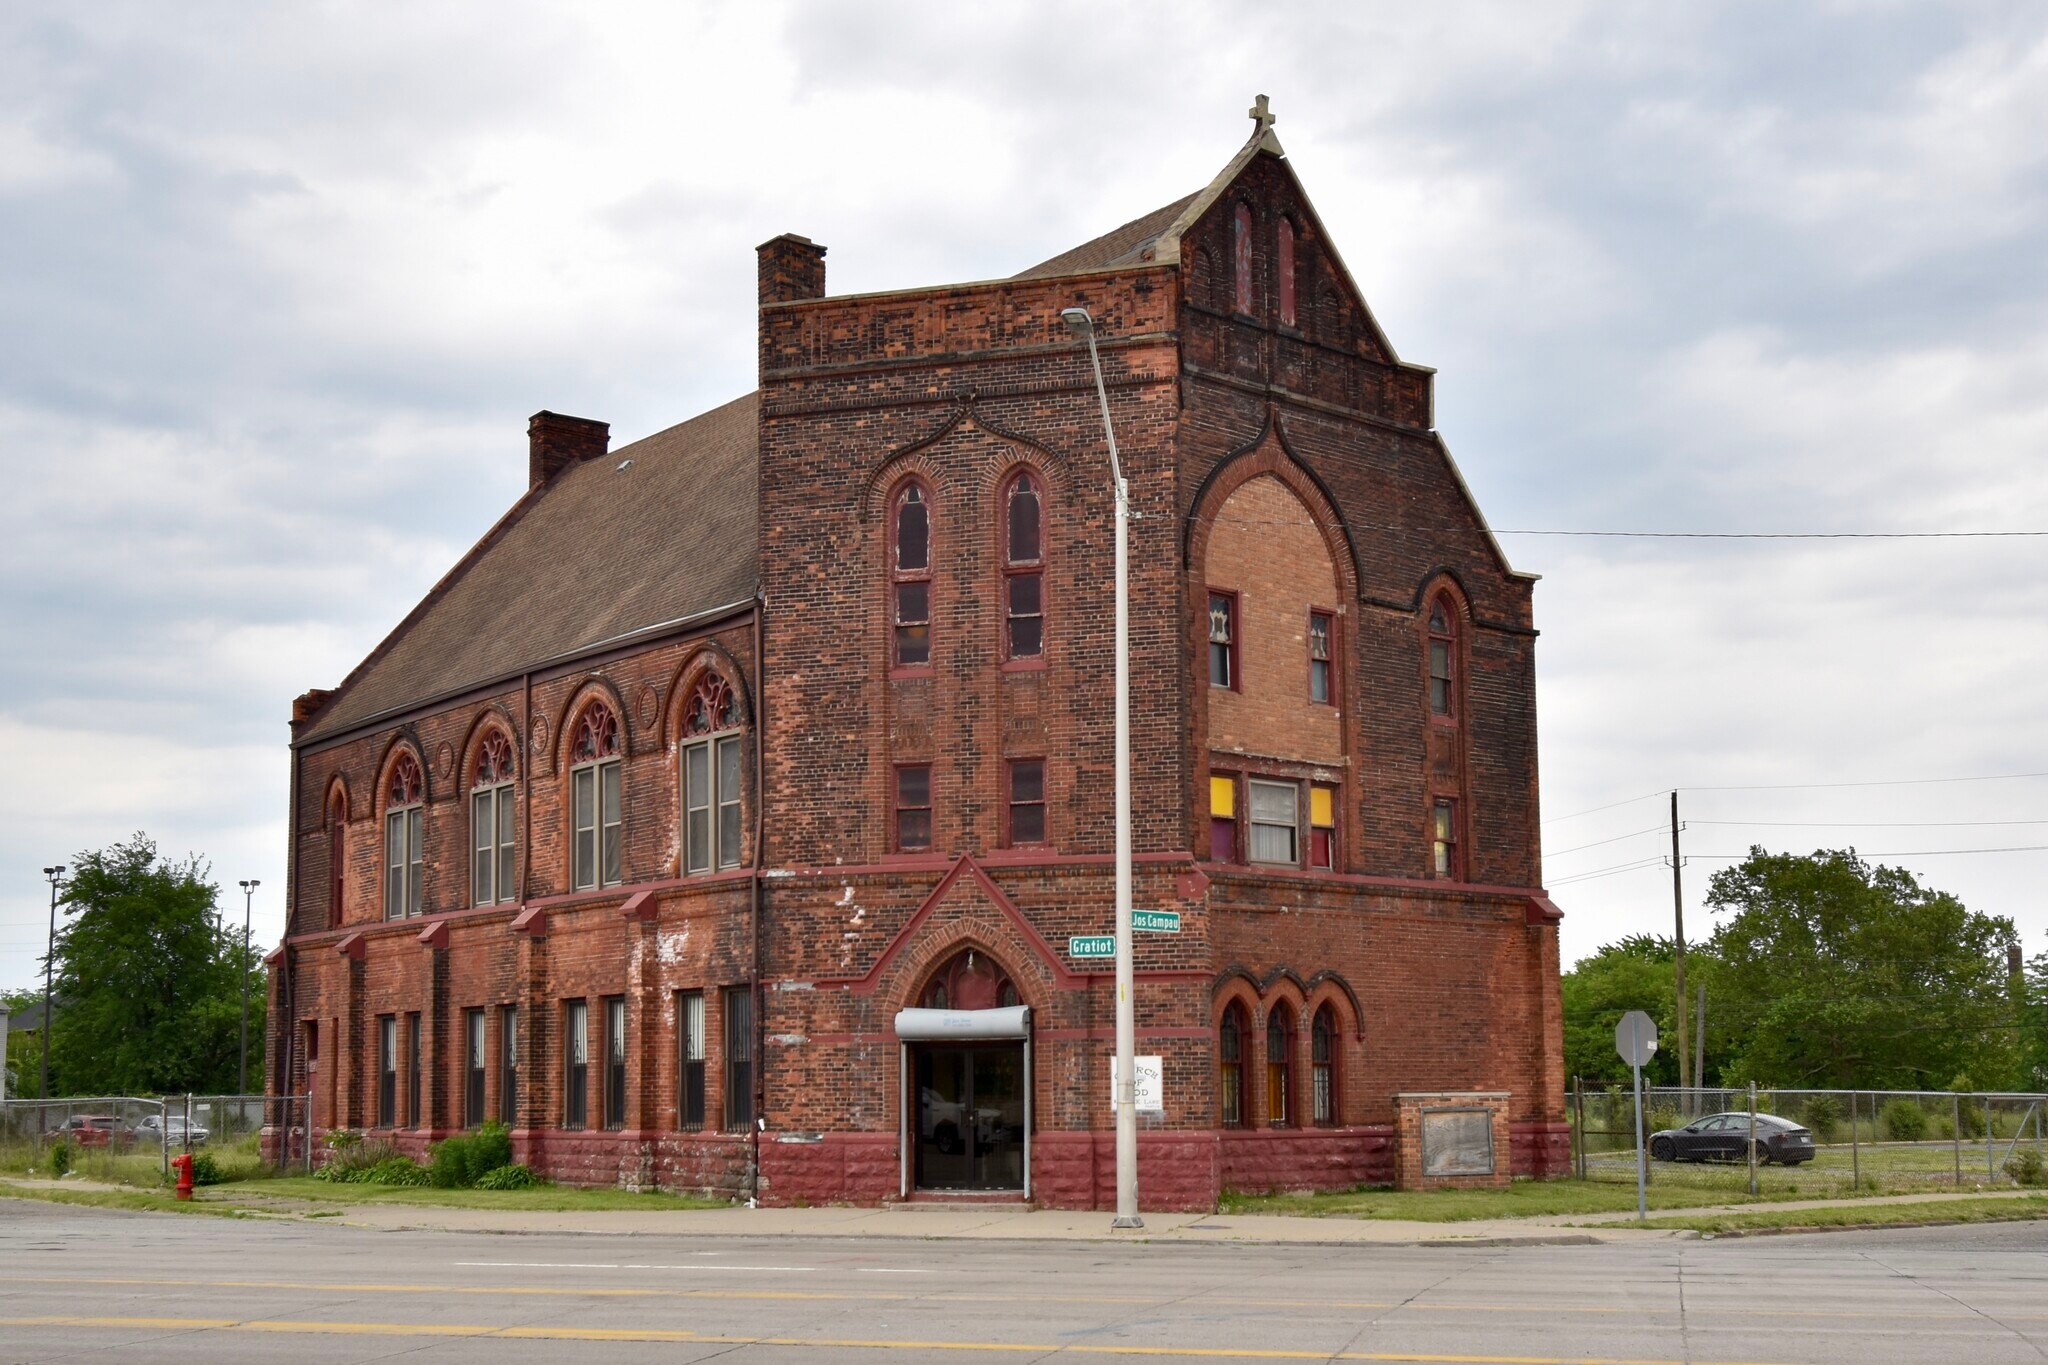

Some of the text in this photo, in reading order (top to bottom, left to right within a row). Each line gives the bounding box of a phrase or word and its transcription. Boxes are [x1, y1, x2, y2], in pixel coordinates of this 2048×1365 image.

[1133, 914, 1178, 930] Jos Campau
[1073, 940, 1111, 953] Gratiot
